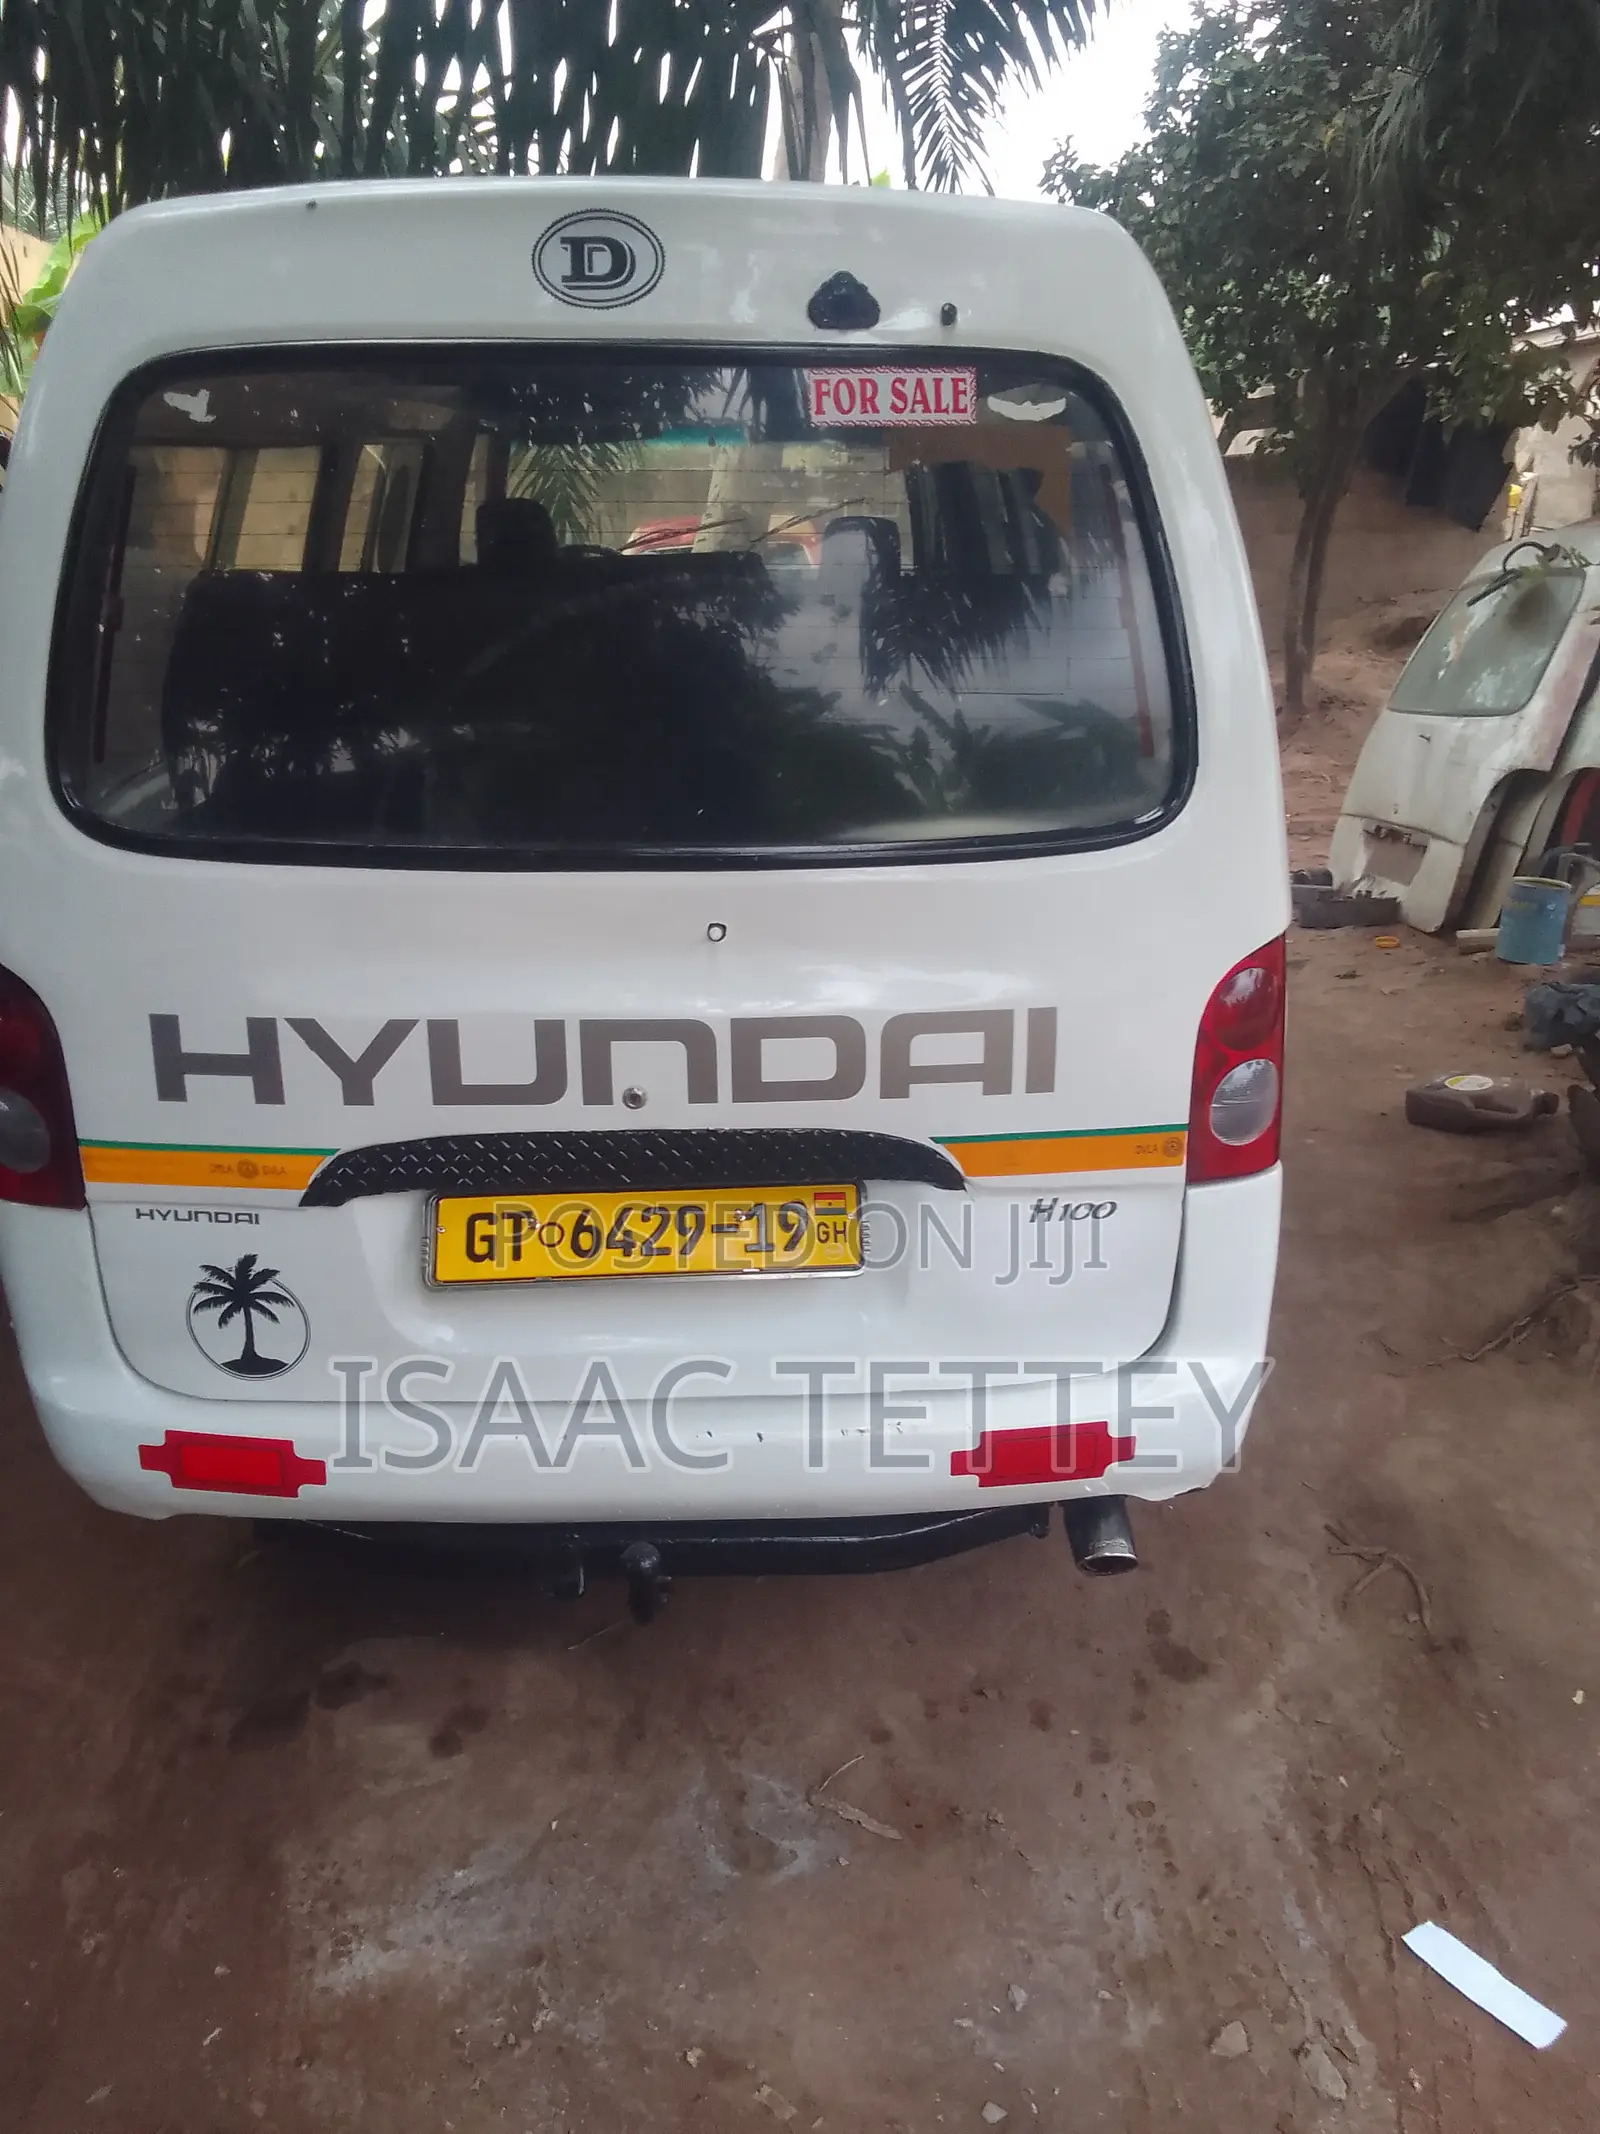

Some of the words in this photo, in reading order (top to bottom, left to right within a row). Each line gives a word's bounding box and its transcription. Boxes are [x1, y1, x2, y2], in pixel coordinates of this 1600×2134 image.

[812, 378, 880, 415] FOR
[889, 377, 969, 414] SALE
[148, 1006, 1058, 1106] HYUNDAI
[135, 1207, 260, 1225] HYUNDAI
[1028, 1197, 1118, 1223] H100
[465, 1210, 534, 1263] GT
[816, 1220, 848, 1244] GH
